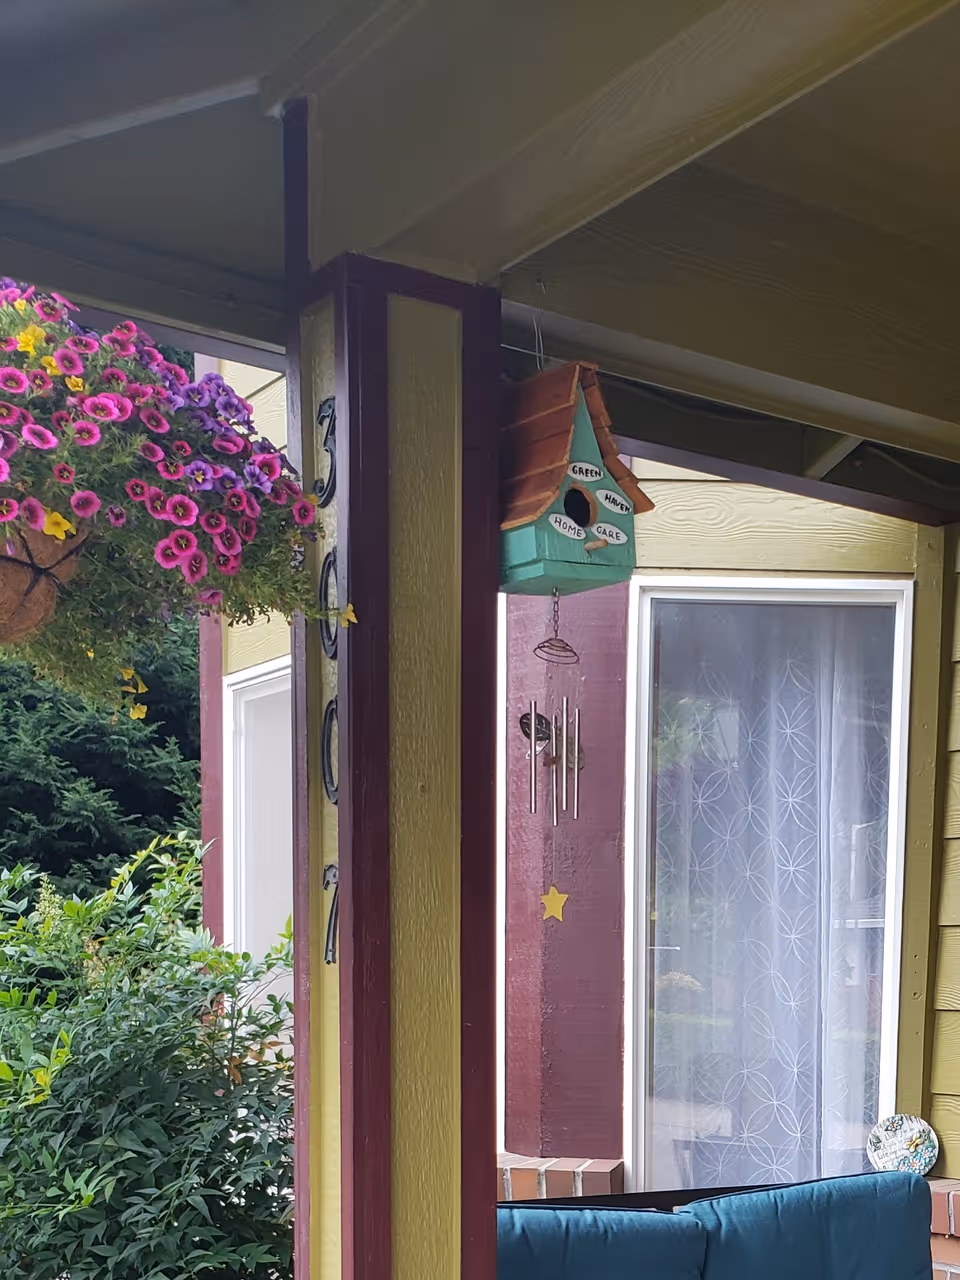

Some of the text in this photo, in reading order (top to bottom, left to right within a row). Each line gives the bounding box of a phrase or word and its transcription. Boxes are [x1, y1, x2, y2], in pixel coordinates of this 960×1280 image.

[572, 464, 602, 477] GREEN
[604, 493, 631, 513] HAVEN
[554, 516, 621, 541] HOME CARE
